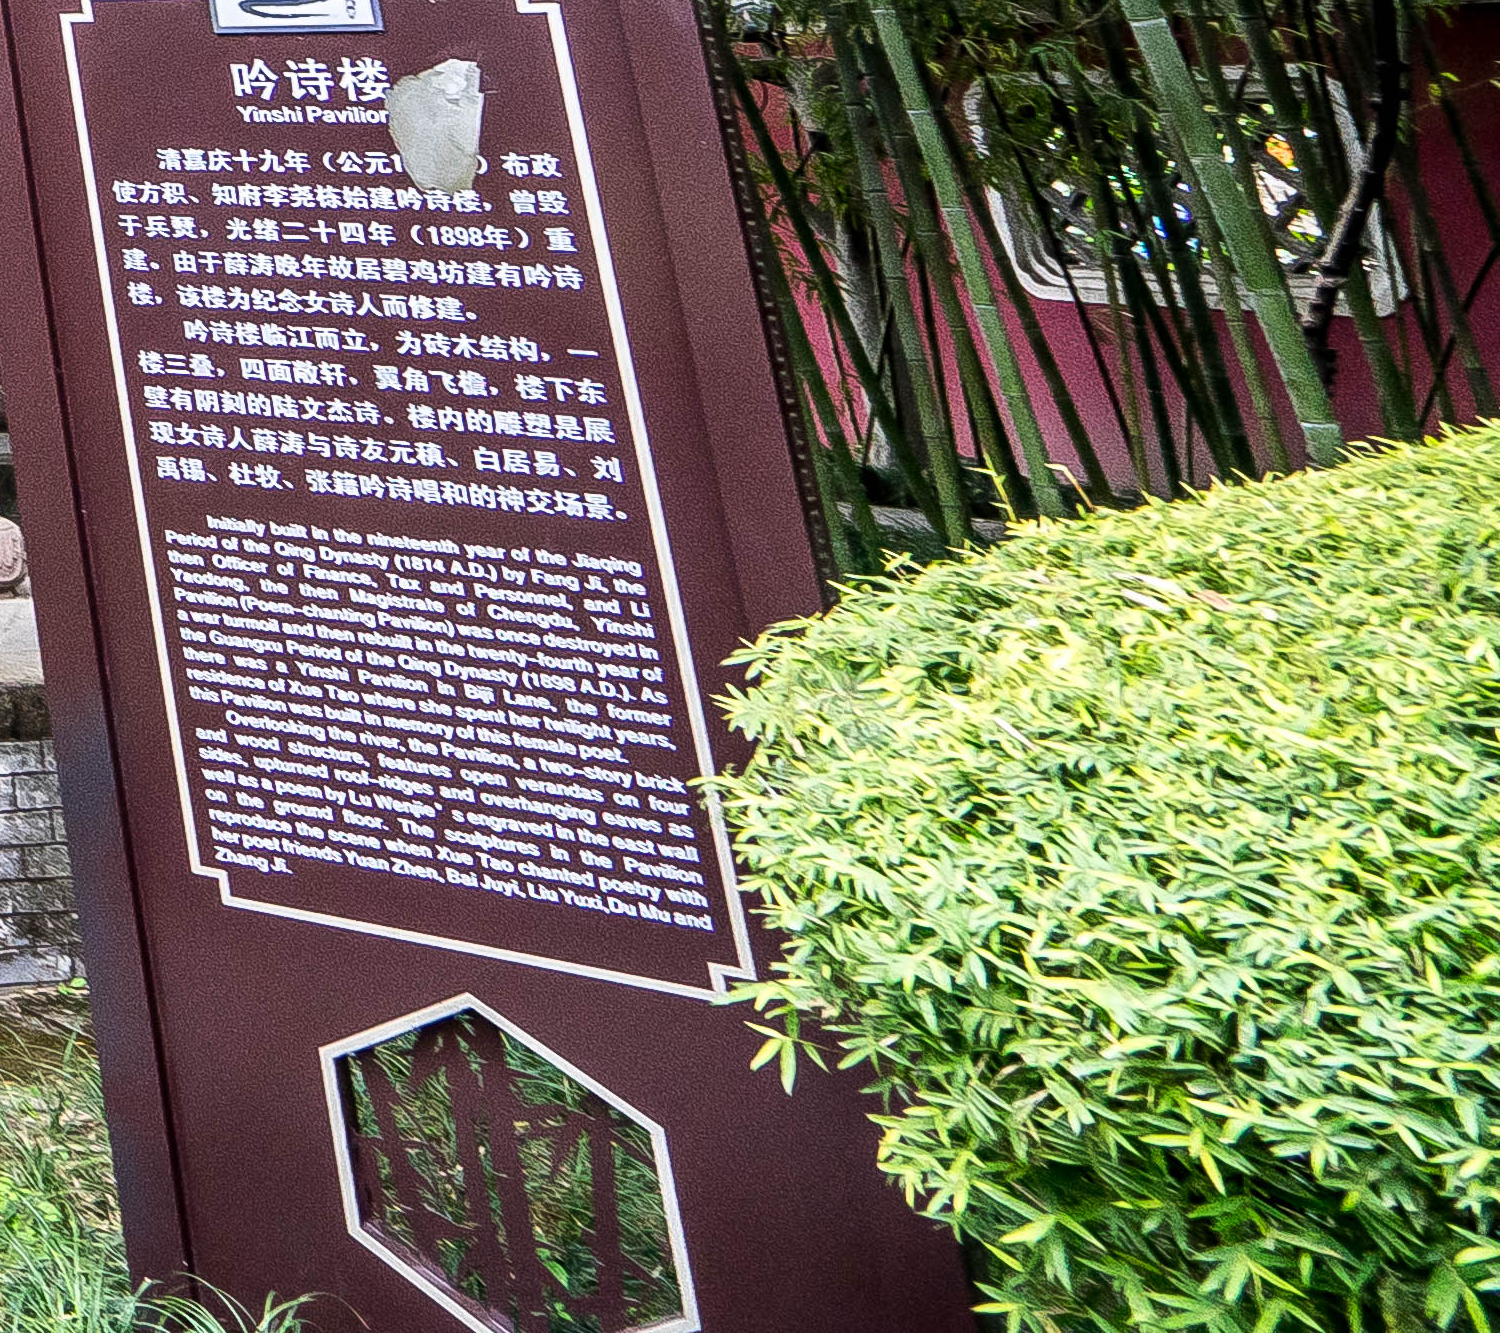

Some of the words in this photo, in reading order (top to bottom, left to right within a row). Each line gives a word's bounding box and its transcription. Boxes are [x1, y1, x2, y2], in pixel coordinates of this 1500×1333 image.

[230, 57, 393, 101] 吟诗楼
[236, 106, 302, 121] Yinshi
[156, 148, 561, 176] 清嘉庆十九年（公元1）布政
[165, 530, 217, 548] Period
[221, 537, 237, 550] of
[242, 539, 269, 553] the
[274, 541, 315, 561] Qing
[319, 546, 388, 569] Dynasty
[501, 566, 524, 584] by
[530, 569, 579, 590] Fang
[613, 579, 645, 594] the
[167, 550, 203, 565] then
[212, 554, 267, 572] Officer
[276, 562, 293, 575] of
[385, 573, 421, 590] Tax
[430, 581, 464, 595] and
[583, 599, 620, 613] and
[630, 601, 649, 616] Li
[269, 521, 307, 538] built
[311, 525, 328, 540] in
[333, 528, 361, 543] the
[366, 532, 459, 553] nineteenth
[463, 544, 505, 558] year
[511, 547, 529, 561] of
[535, 549, 566, 565] the
[571, 553, 641, 576] Jiaqing
[173, 587, 238, 607] Pavilion
[456, 624, 493, 638] was
[495, 629, 540, 644] once
[543, 632, 636, 656] destroyed
[638, 643, 658, 659] in
[259, 578, 287, 593] the
[299, 583, 338, 599] then
[349, 588, 444, 612] Magistrate
[456, 602, 475, 615] of
[590, 616, 654, 637] Yinshi
[180, 627, 205, 641] the
[286, 640, 341, 660] Period
[366, 651, 394, 666] the
[398, 654, 441, 676] Qing
[443, 660, 517, 686] Dynasty
[641, 687, 667, 703] As
[190, 611, 220, 624] war
[282, 623, 313, 636] and
[316, 625, 354, 641] then
[357, 631, 413, 649] rebuilt
[435, 639, 464, 655] the
[595, 662, 638, 678] year
[642, 667, 661, 681] of
[183, 646, 225, 663] there
[233, 655, 267, 669] was
[295, 661, 349, 681] Yinshi
[357, 669, 428, 691] Pavilion
[565, 698, 597, 715] the
[606, 703, 671, 725] former
[186, 668, 265, 688] residence
[287, 679, 322, 696] Xue
[324, 684, 358, 702] Tao
[361, 692, 415, 710] where
[418, 699, 451, 715] she
[455, 706, 506, 723] spent
[508, 710, 540, 728] her
[189, 686, 219, 701] this
[220, 689, 286, 711] Pavilion
[288, 702, 322, 716] was
[324, 704, 363, 723] built
[383, 716, 453, 739] memory
[476, 727, 511, 744] this
[512, 732, 576, 754] female
[196, 728, 227, 742] and
[234, 734, 279, 750] wood
[377, 753, 451, 777] features
[460, 769, 506, 786] open
[515, 777, 603, 801] verandas
[648, 795, 688, 814] four
[225, 710, 325, 740] Overlooking
[327, 726, 356, 742] the
[407, 738, 437, 754] the
[634, 771, 685, 793] brick
[201, 768, 235, 783] well
[274, 780, 322, 798] poem
[324, 785, 345, 804] by
[466, 812, 553, 836] engraved
[612, 836, 655, 854] east
[657, 844, 698, 861] wall
[273, 800, 332, 820] ground
[397, 818, 433, 837] The
[623, 856, 702, 883] Pavilion
[439, 786, 474, 801] and
[602, 812, 661, 832] eaves
[208, 809, 291, 832] reproduce
[328, 829, 379, 848] scene
[383, 838, 432, 857] when
[435, 845, 472, 864] Xue
[475, 852, 513, 871] Tao
[518, 861, 594, 886] chanted
[598, 877, 660, 901] poetry
[664, 888, 707, 906] with
[211, 826, 239, 843] her
[242, 834, 280, 851] poet
[281, 838, 342, 861] friends
[342, 849, 389, 870] Yuan
[445, 867, 477, 886] Bai
[527, 882, 558, 901] Liu
[673, 912, 712, 929] and
